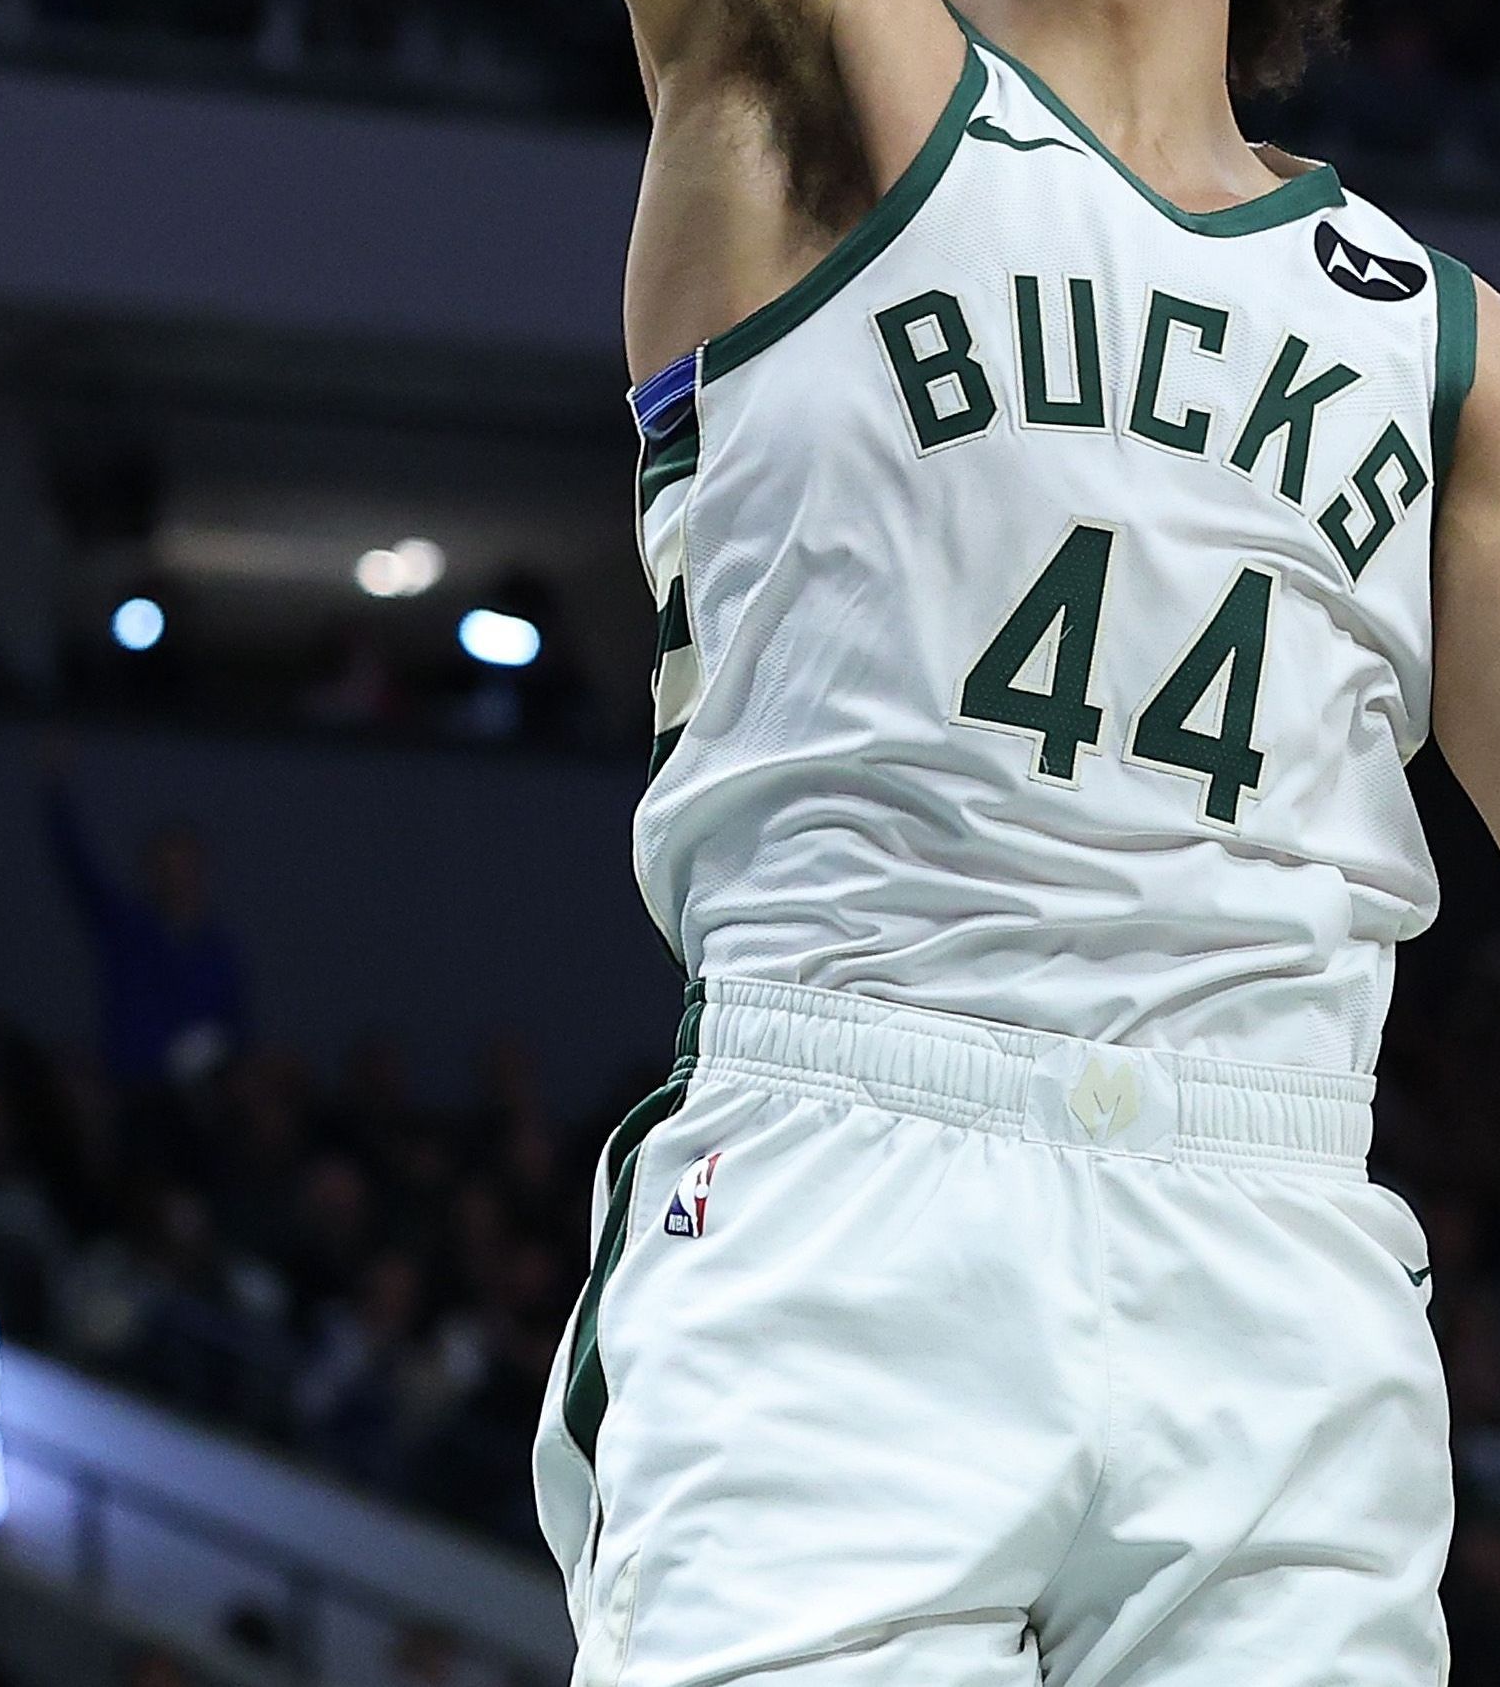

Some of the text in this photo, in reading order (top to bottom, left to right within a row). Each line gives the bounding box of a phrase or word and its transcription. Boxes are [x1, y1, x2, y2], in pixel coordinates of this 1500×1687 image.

[871, 271, 1433, 592] BUCKS
[949, 515, 1282, 835] 44
[668, 1214, 690, 1233] NBA
